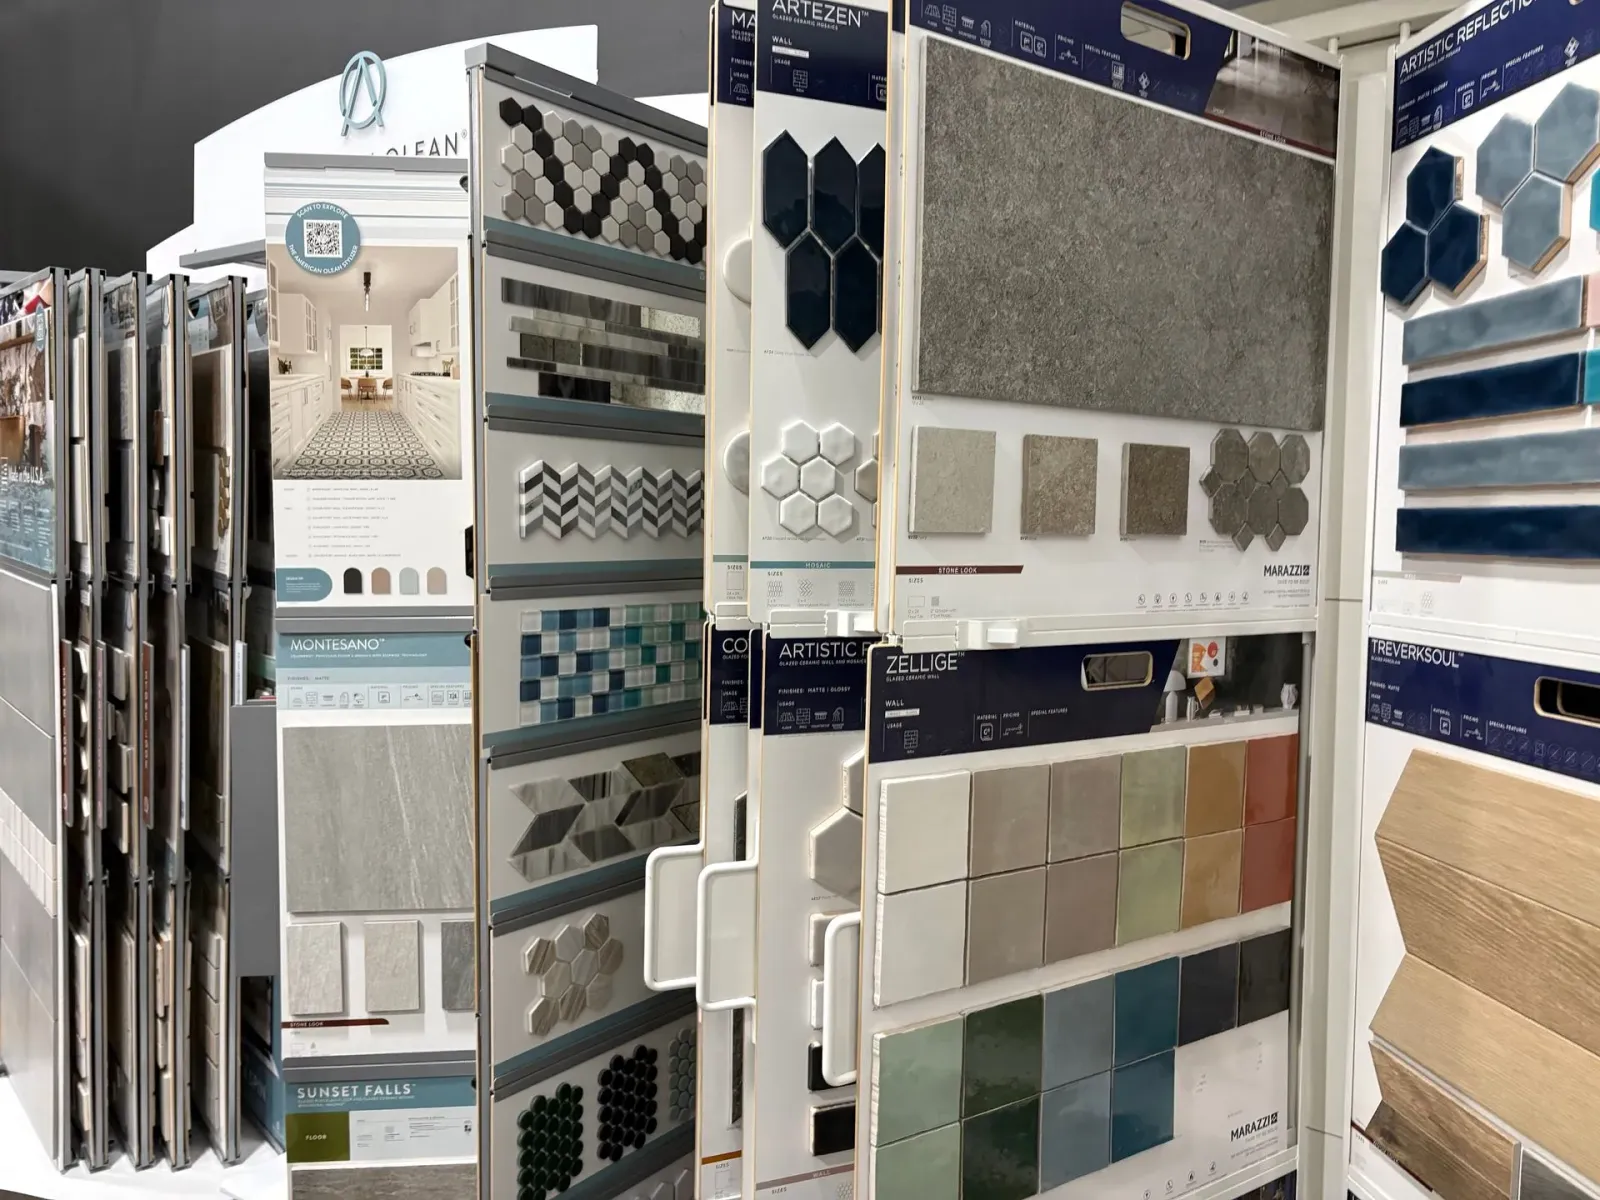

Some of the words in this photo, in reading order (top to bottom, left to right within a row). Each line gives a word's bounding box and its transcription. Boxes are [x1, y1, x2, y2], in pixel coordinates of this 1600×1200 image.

[771, 35, 793, 46] WALL
[1399, 33, 1454, 78] ARTISTIC
[297, 204, 313, 219] SCAN
[322, 203, 349, 220] EXPLORE
[295, 254, 323, 274] AMERICAN
[323, 264, 343, 274] OLEAN
[960, 566, 978, 574] LOOK
[1263, 564, 1303, 577] MARAZZI
[779, 642, 857, 659] ARTISTIC
[885, 675, 905, 683] GLAZED
[885, 699, 905, 708] WALL
[297, 1085, 359, 1099] SUNSET
[1230, 1114, 1271, 1142] MARAZZI
[812, 1170, 831, 1179] WALL
